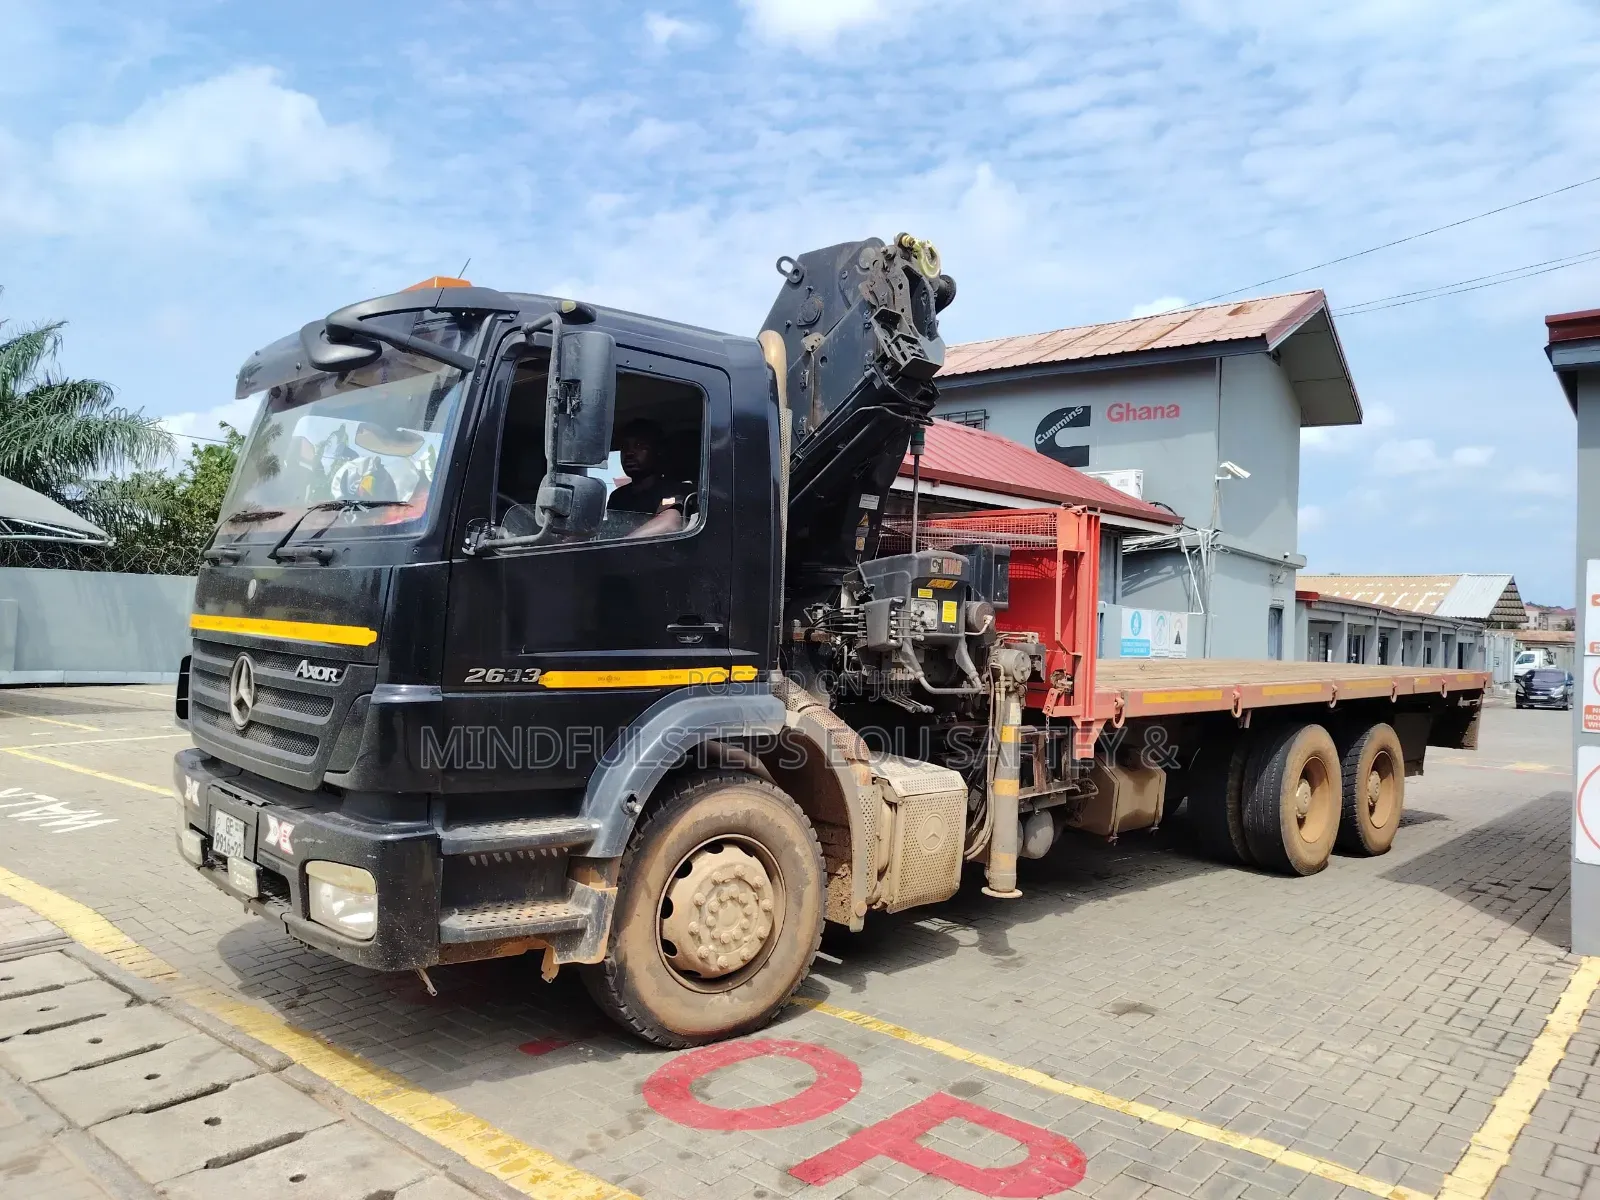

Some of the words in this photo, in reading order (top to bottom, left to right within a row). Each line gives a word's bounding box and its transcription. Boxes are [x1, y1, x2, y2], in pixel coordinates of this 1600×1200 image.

[1106, 402, 1181, 423] Ghana
[1034, 405, 1084, 445] Cummins
[463, 667, 544, 684] 2633
